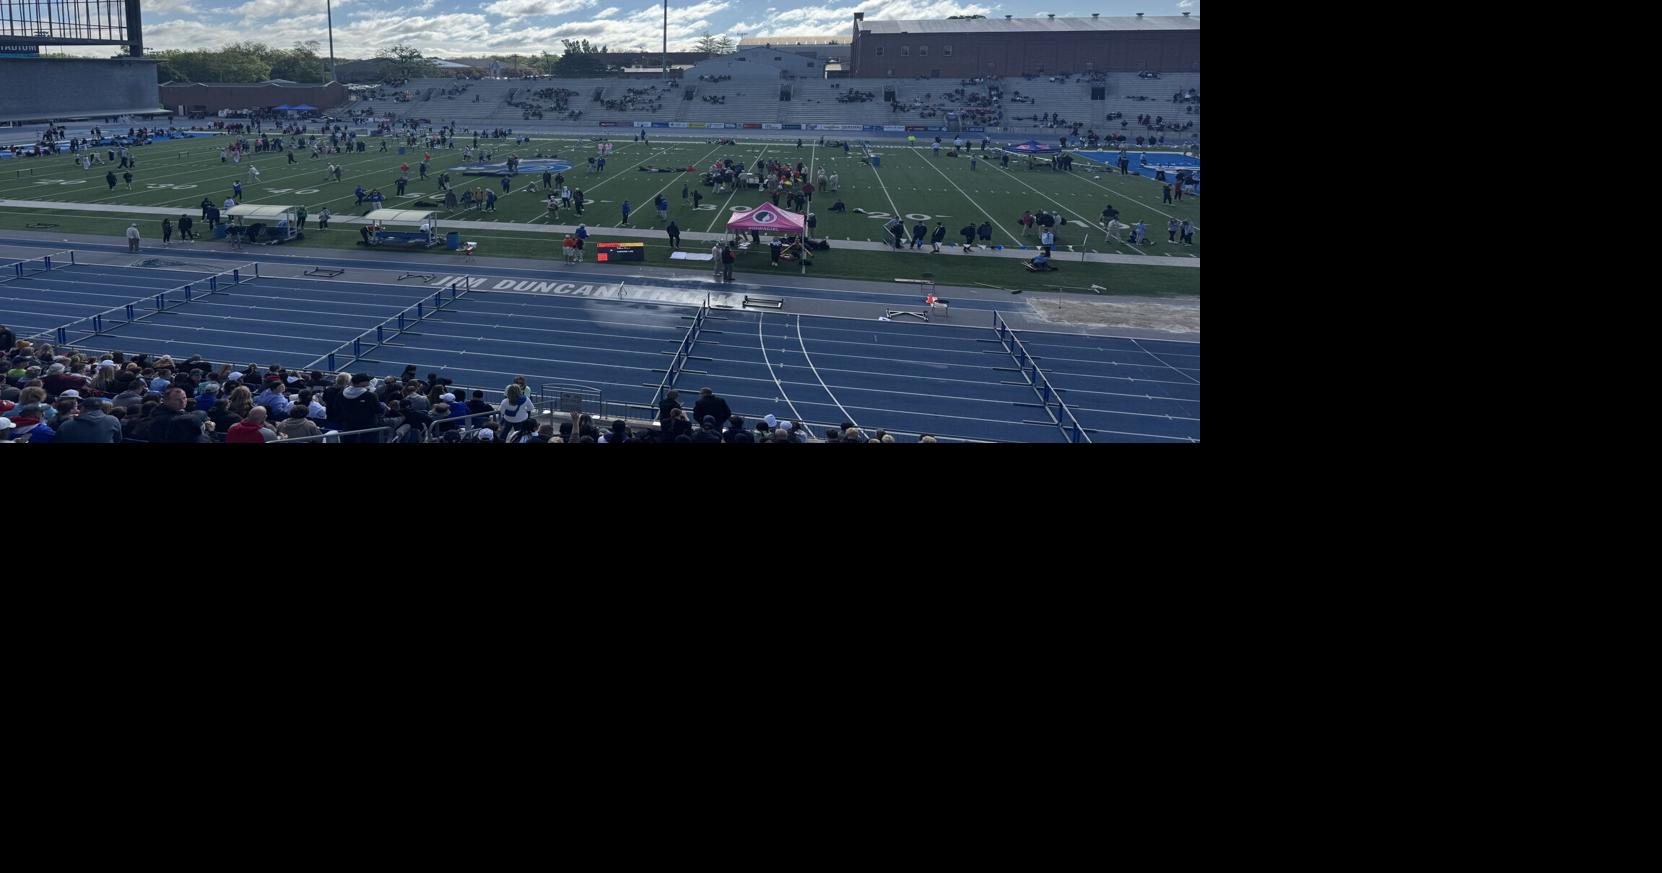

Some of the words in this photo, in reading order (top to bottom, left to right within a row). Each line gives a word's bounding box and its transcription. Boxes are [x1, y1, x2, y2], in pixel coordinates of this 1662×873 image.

[867, 211, 932, 221] 20
[430, 275, 487, 289] JIM
[491, 278, 620, 298] DUNCAN
